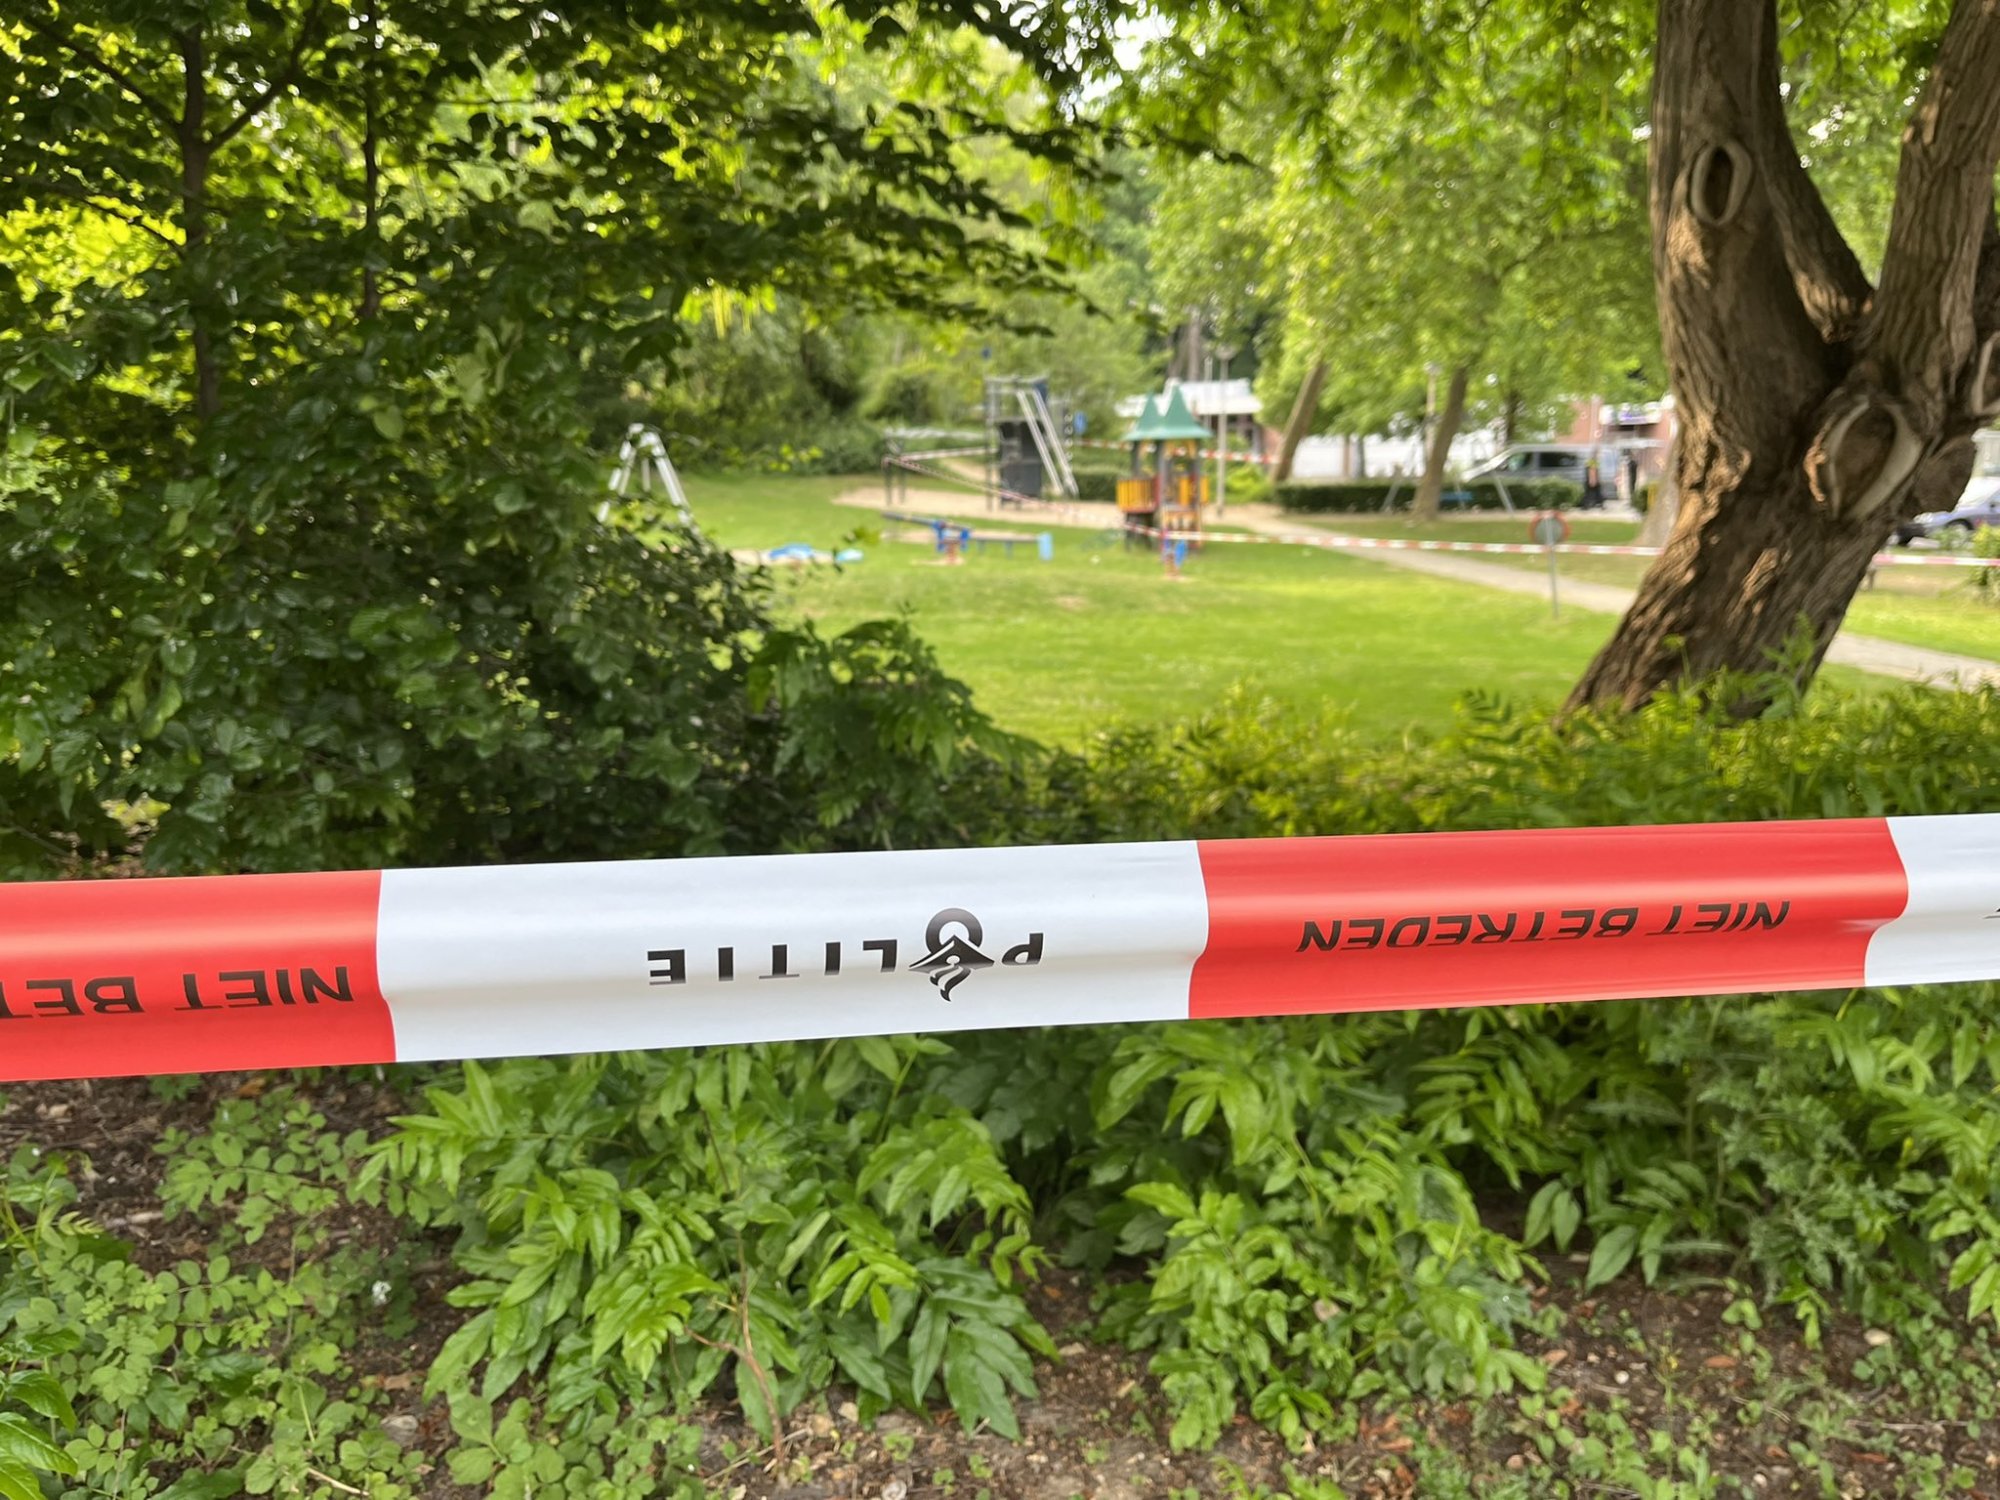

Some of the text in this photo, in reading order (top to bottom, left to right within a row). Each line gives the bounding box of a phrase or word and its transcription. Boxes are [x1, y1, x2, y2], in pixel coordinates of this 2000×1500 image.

[1295, 900, 1790, 953] NIET BETREDEN
[173, 966, 354, 1011] NIET
